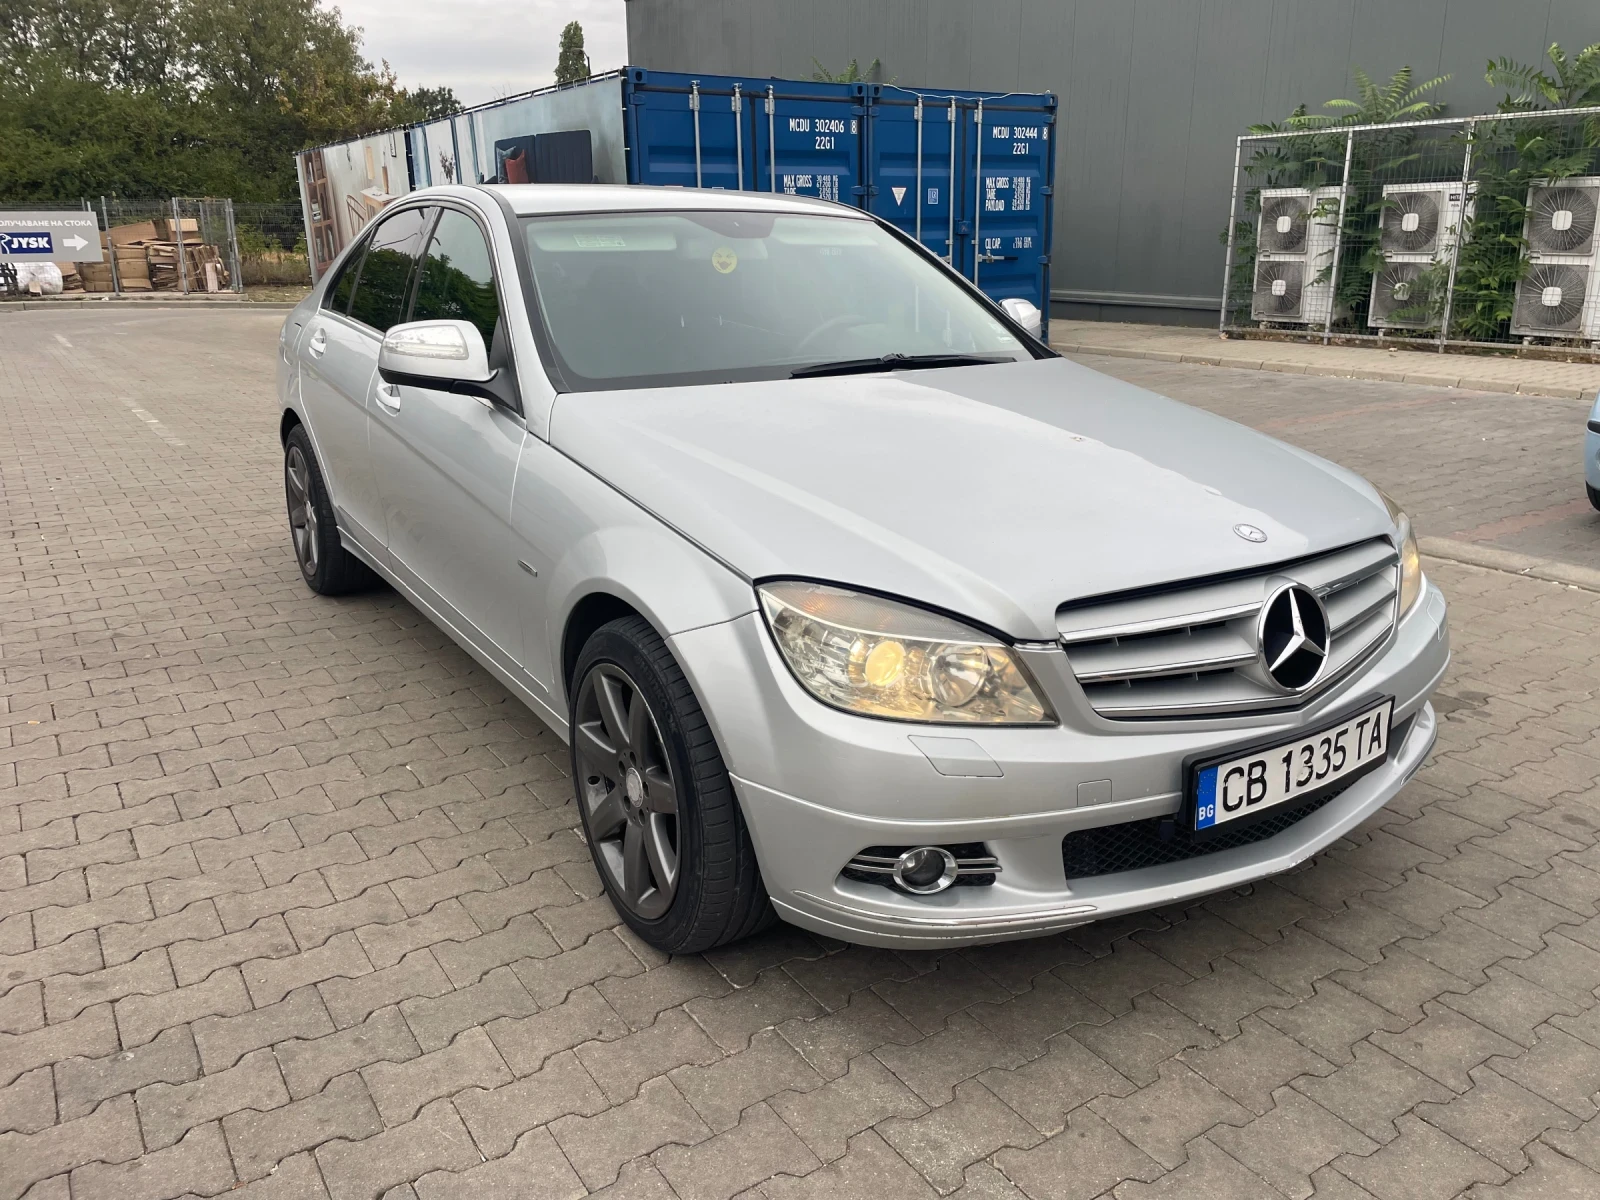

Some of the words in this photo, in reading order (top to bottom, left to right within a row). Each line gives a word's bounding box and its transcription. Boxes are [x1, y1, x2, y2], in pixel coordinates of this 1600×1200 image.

[789, 118, 810, 132] MCDU
[815, 119, 845, 133] 302406
[992, 126, 1010, 139] MCDU
[1013, 127, 1038, 139] 302444
[815, 136, 835, 150] 22G1
[1012, 142, 1029, 155] 22G1
[783, 174, 795, 187] MAX
[796, 174, 812, 188] GROSS
[985, 177, 995, 189] MAX
[996, 177, 1009, 189] GROSS
[986, 188, 996, 200] TARE
[985, 199, 1005, 211] PAYLOAD
[11, 237, 51, 249] JYSK
[1222, 759, 1268, 812] CB
[1281, 727, 1349, 794] 1335
[1355, 711, 1382, 761] TA
[1198, 804, 1214, 821] BG
